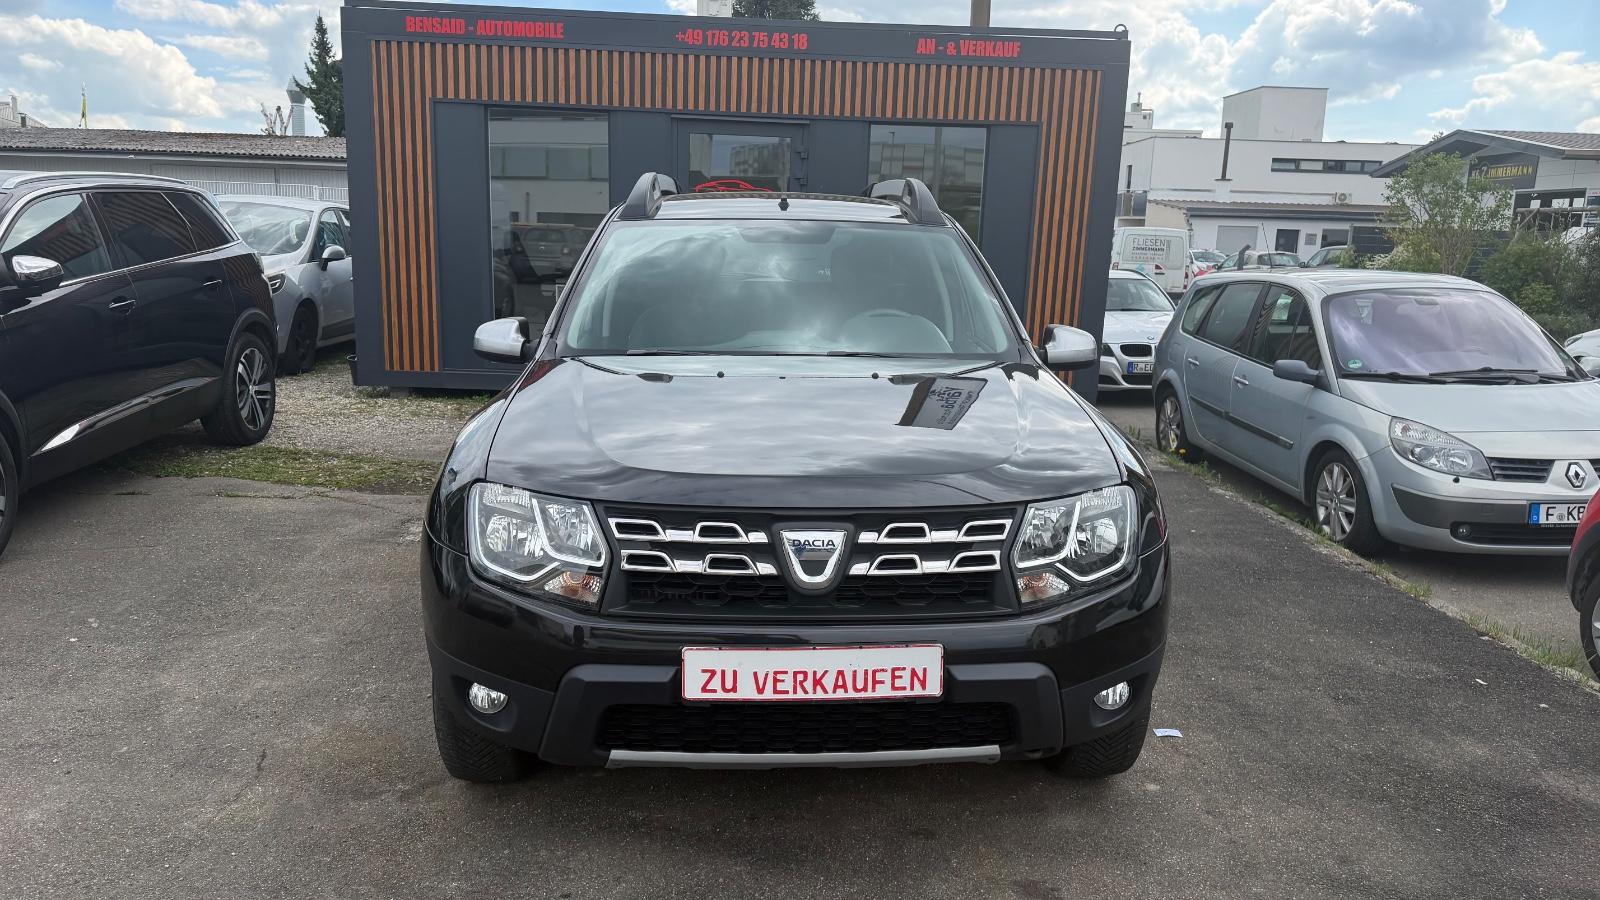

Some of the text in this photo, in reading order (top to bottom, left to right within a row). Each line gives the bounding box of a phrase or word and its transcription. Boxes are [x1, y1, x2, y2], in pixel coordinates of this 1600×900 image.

[405, 16, 465, 35] BENSAID
[476, 19, 565, 39] AUTOMOBILE
[675, 29, 808, 50] +49 176 23 75 43 18
[917, 38, 936, 55] AN
[946, 41, 957, 56] &
[959, 39, 1021, 57] VERKAUF
[1132, 238, 1166, 247] FLIESEN
[1545, 506, 1557, 522] F
[792, 539, 836, 548] DACIA
[700, 667, 928, 695] ZU VERKAUFEN
